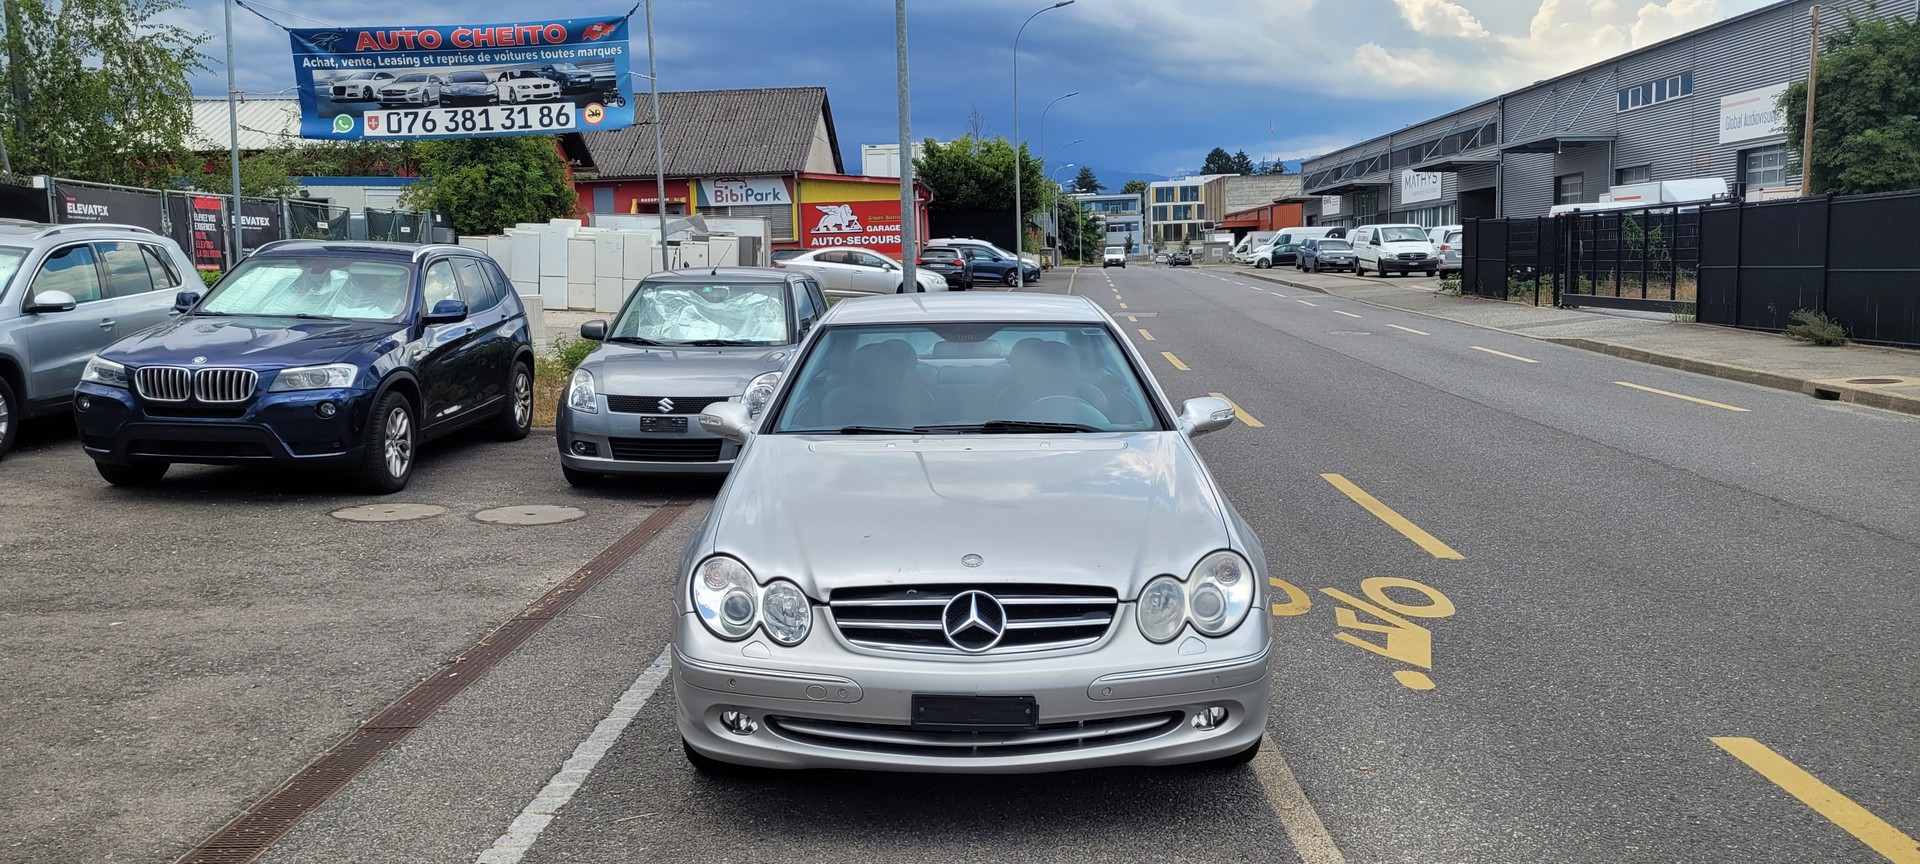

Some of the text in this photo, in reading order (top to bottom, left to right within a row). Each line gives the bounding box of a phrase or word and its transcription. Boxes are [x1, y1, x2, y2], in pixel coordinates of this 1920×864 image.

[355, 23, 567, 52] AUTO CHEITO
[302, 45, 622, 69] Achat, vente, Leasing et reprise de voitures toutes marques
[386, 104, 571, 134] 076 381 31 86
[1725, 113, 1742, 131] Global
[1404, 171, 1438, 189] MATHYS
[714, 186, 782, 203] BibiPark
[67, 202, 109, 216] ELEVATEX
[231, 215, 270, 226] EEVATEX
[866, 224, 901, 232] GARAGE
[811, 235, 902, 246] AUTO-SECOURS
